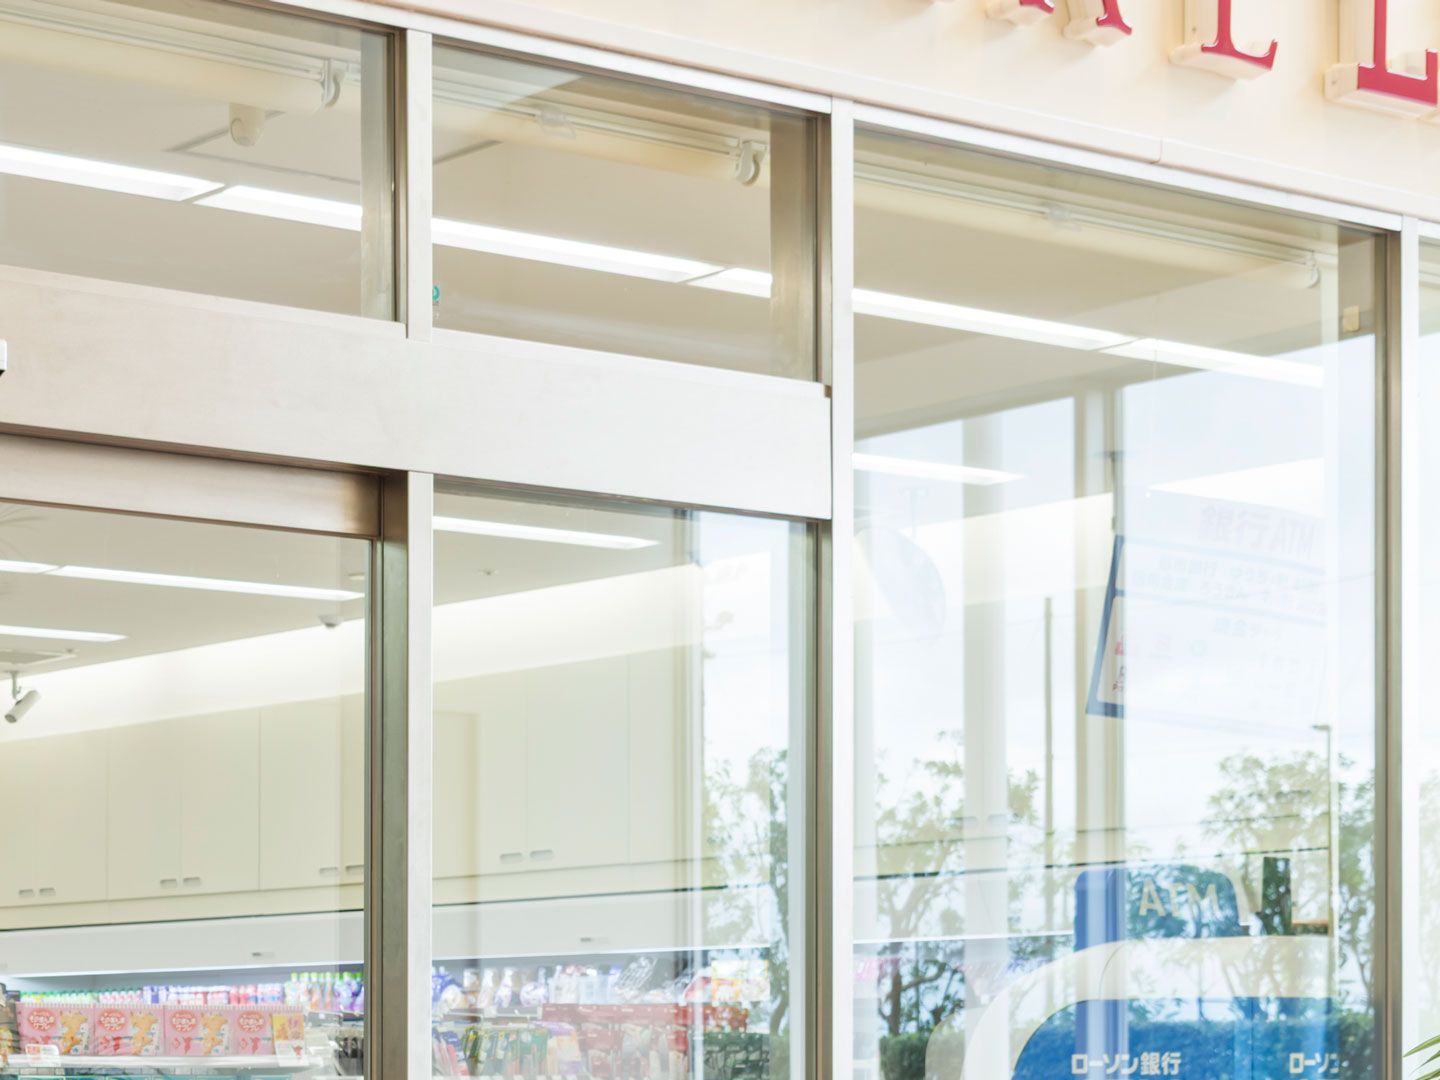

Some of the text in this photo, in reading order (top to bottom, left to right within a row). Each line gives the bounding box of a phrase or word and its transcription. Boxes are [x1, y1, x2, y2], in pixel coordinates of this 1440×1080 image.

[1071, 1051, 1181, 1075] ローソン銀行
